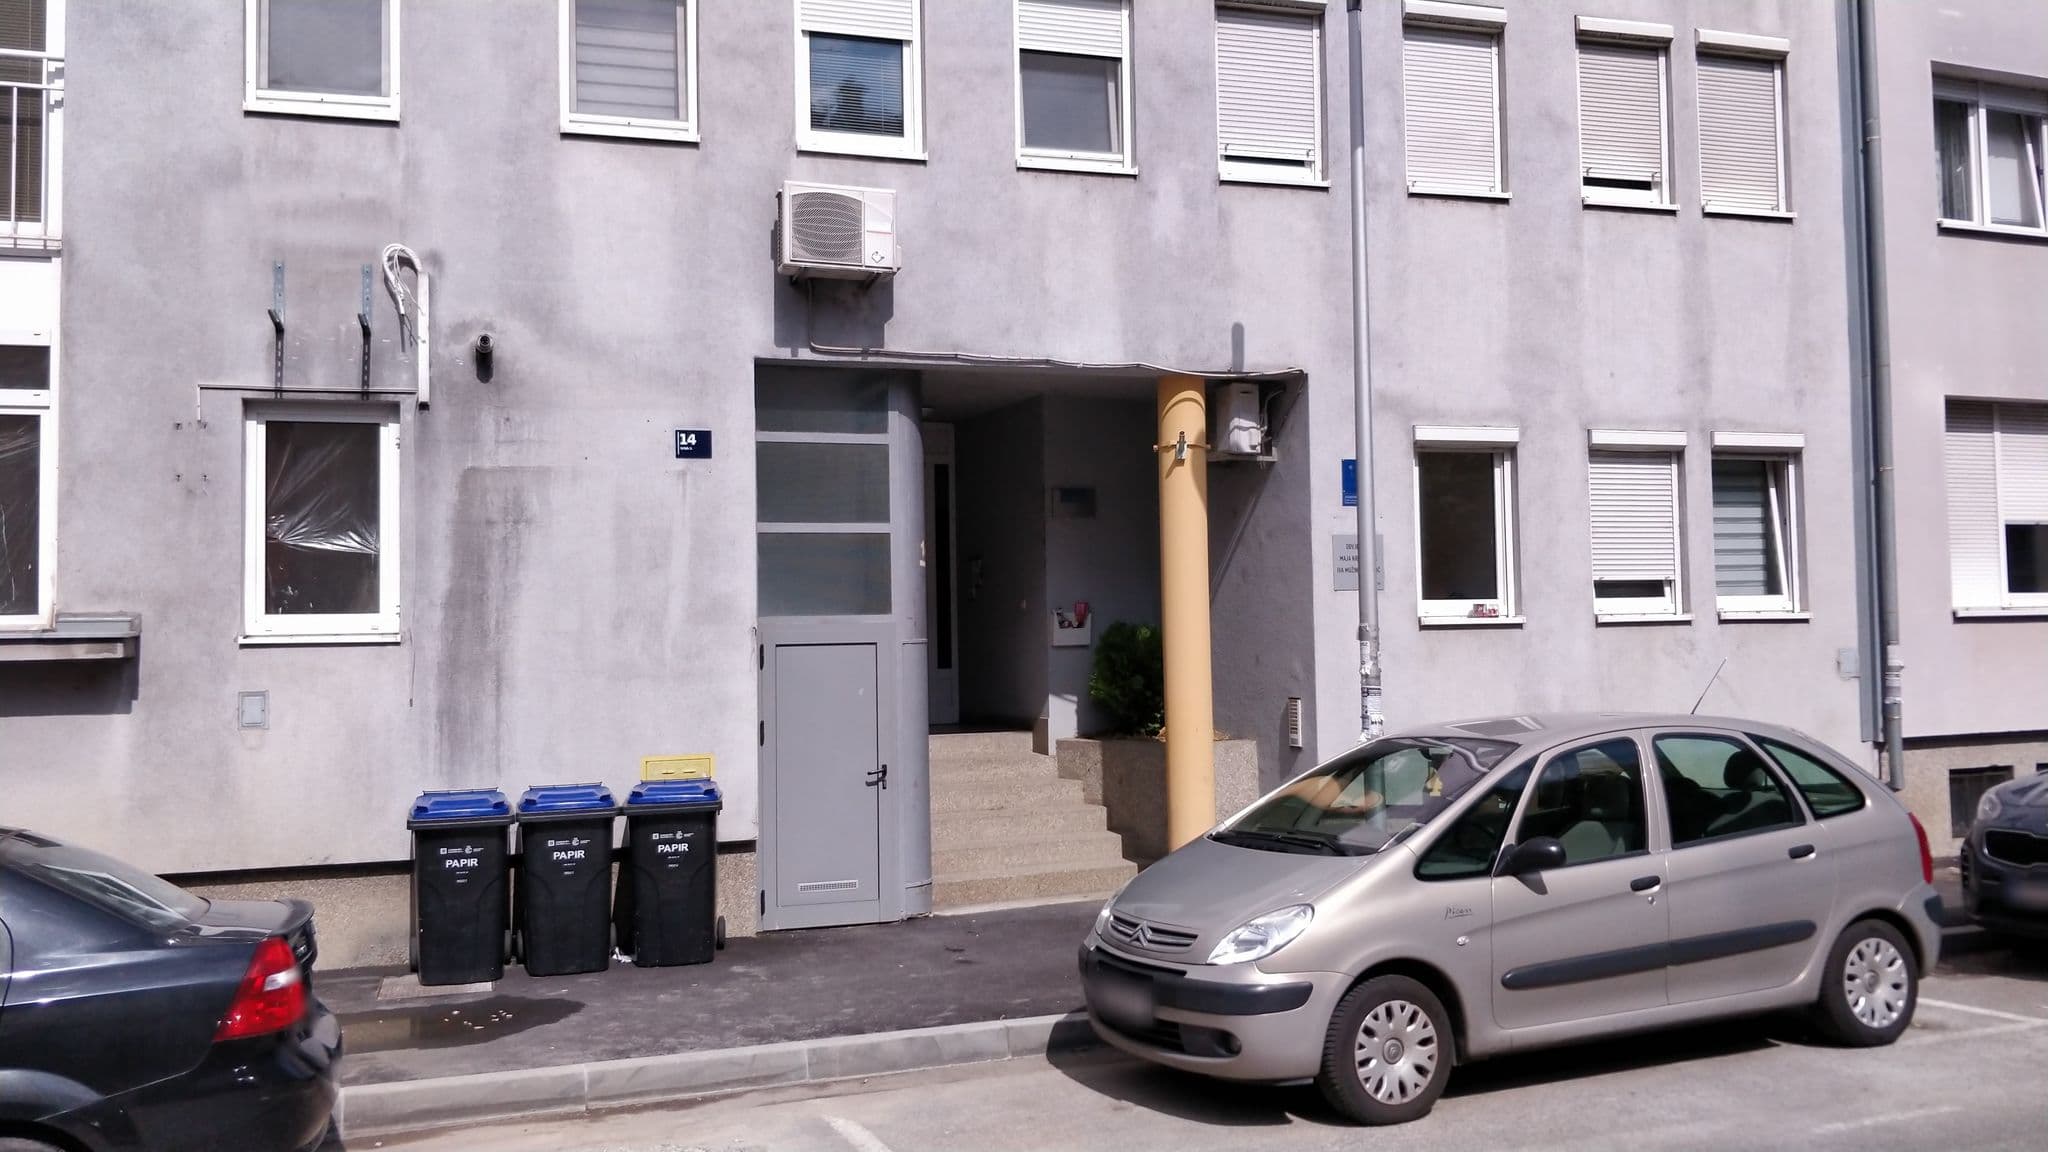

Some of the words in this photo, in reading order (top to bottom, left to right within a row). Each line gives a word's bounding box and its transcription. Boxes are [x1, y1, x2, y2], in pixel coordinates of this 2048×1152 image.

[679, 433, 697, 446] 14
[657, 843, 689, 853] PAPIR
[553, 849, 585, 860] PAPIR
[445, 857, 478, 868] PAPIR
